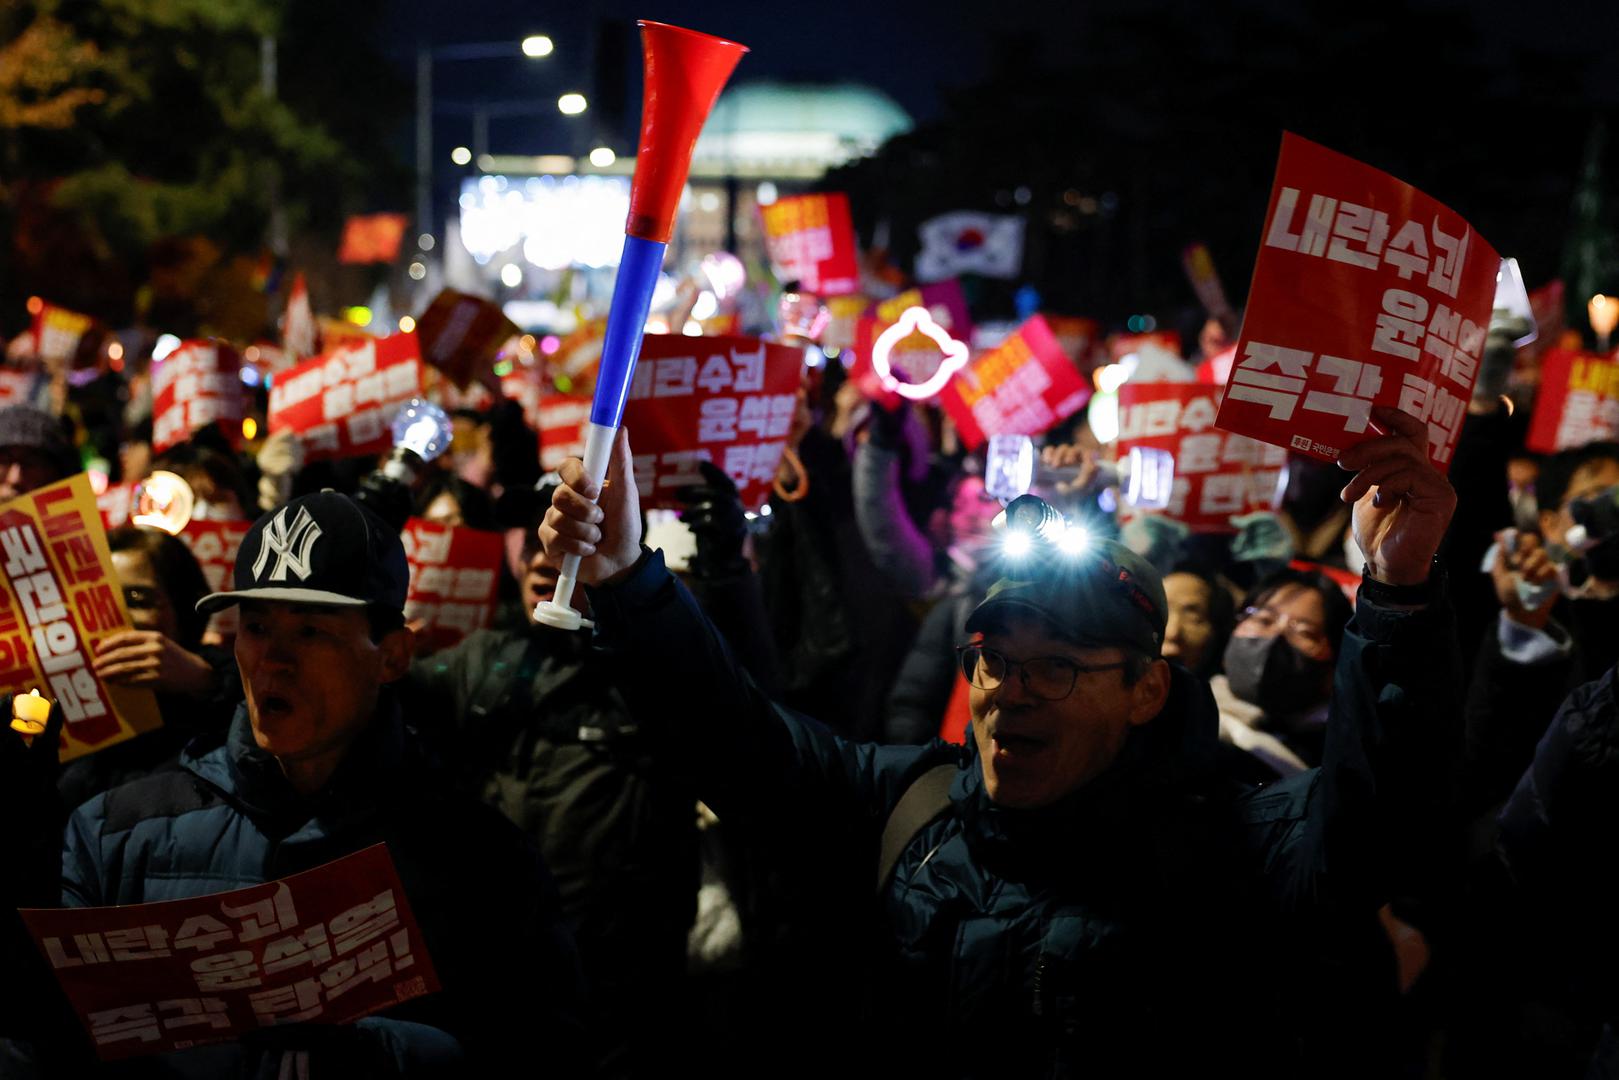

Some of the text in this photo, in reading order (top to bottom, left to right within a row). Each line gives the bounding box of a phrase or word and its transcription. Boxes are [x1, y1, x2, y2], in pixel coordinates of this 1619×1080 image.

[1265, 186, 1470, 299] 내란수괴
[1227, 340, 1384, 434] 즉각
[1371, 288, 1486, 390] 윤석열
[32, 486, 126, 656] 내란동
[252, 505, 322, 582] NY
[1, 524, 107, 724] 국민의힘
[42, 881, 299, 968] 내란수괴
[190, 888, 400, 993] 윤석열
[87, 928, 415, 1045] 즉각 탄핵!
